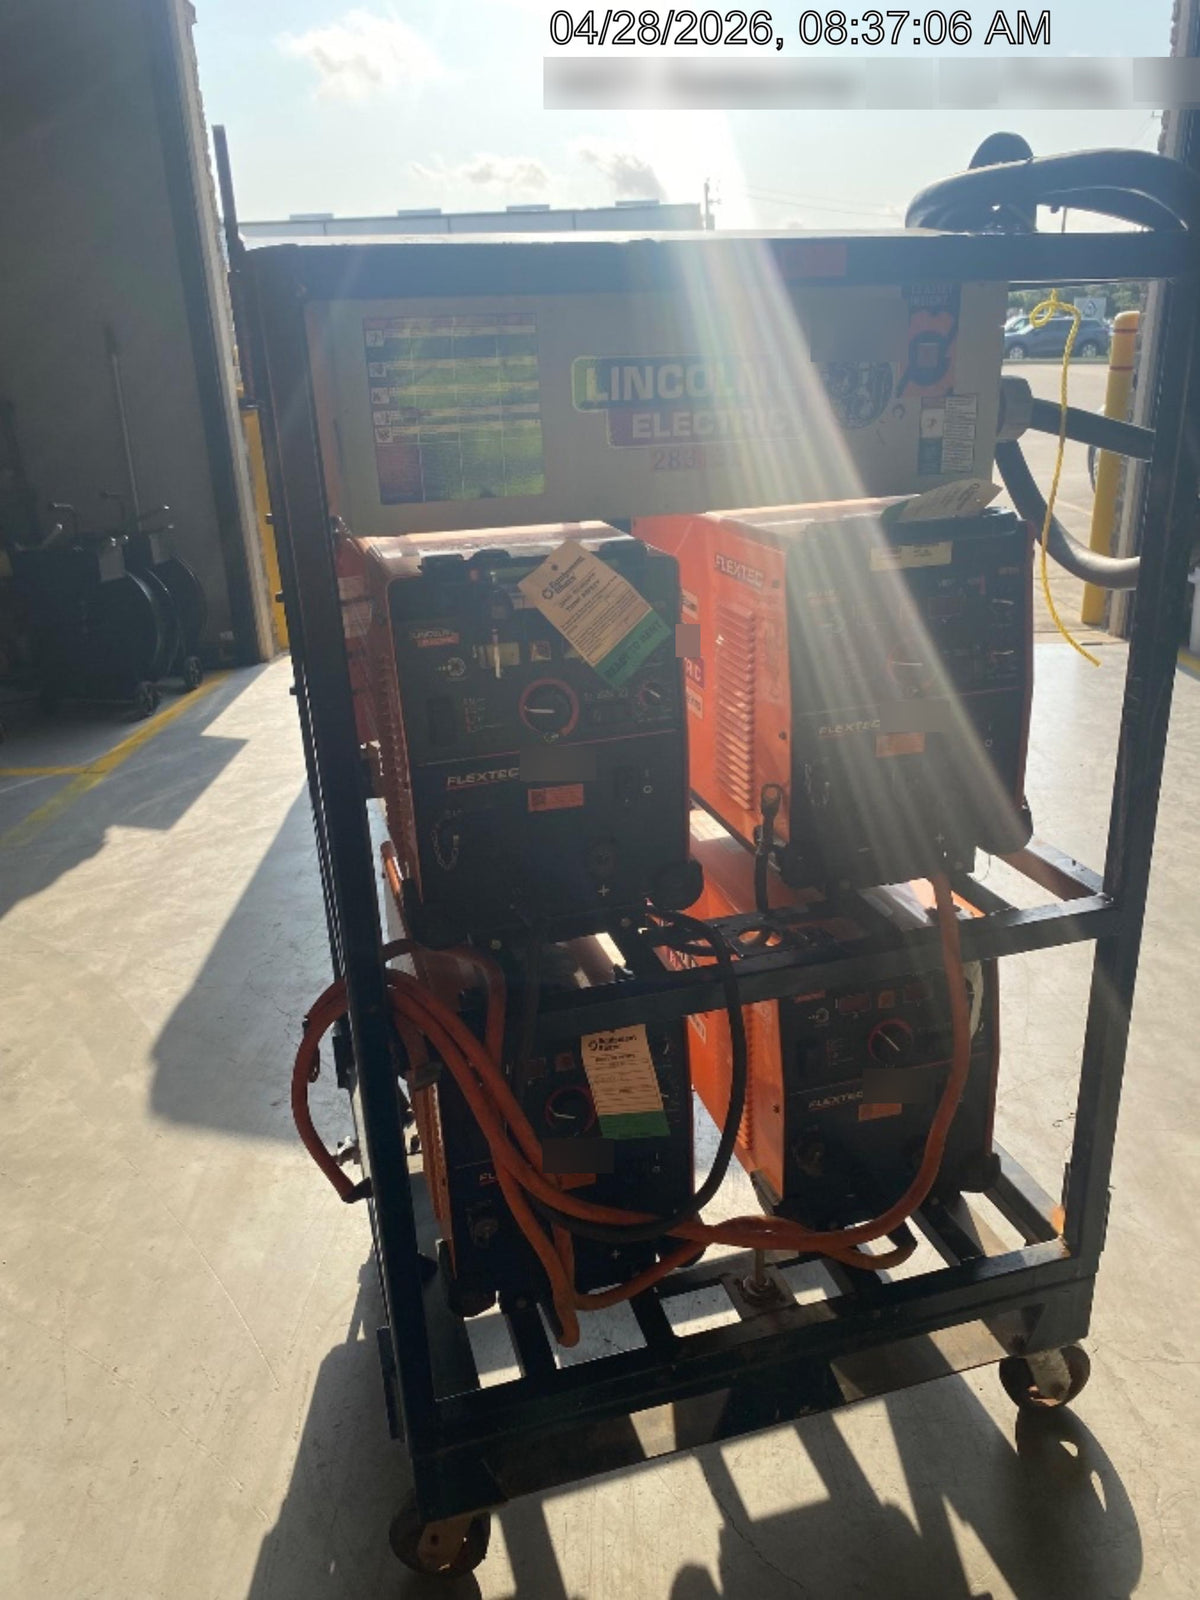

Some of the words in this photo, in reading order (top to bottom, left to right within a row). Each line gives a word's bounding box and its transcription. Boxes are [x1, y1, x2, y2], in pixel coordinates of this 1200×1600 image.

[586, 362, 769, 402] LINCOLN
[632, 408, 797, 440] ELECTRIC
[715, 553, 765, 589] FLEXTEC
[447, 766, 520, 787] FLEXTEC
